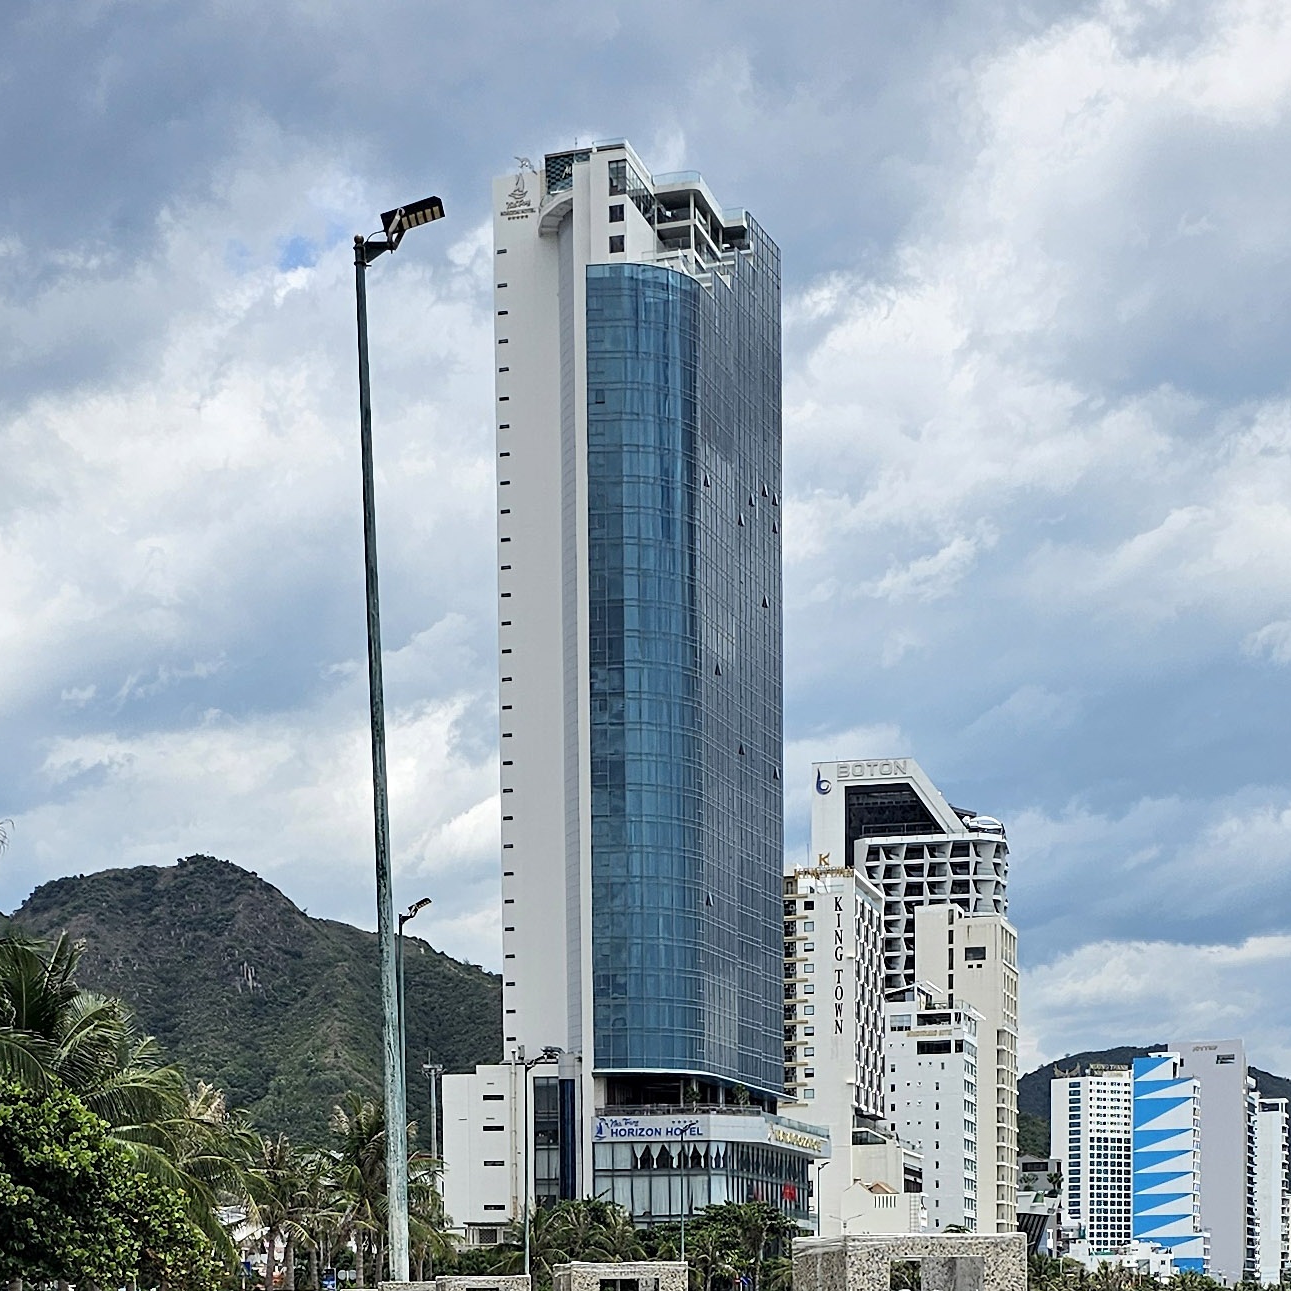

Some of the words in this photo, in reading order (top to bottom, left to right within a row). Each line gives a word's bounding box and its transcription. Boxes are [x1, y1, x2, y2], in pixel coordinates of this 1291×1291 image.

[836, 760, 907, 779] BOTON
[834, 896, 843, 962] KING
[834, 969, 844, 1035] TOWN
[610, 1127, 662, 1138] HORIZON
